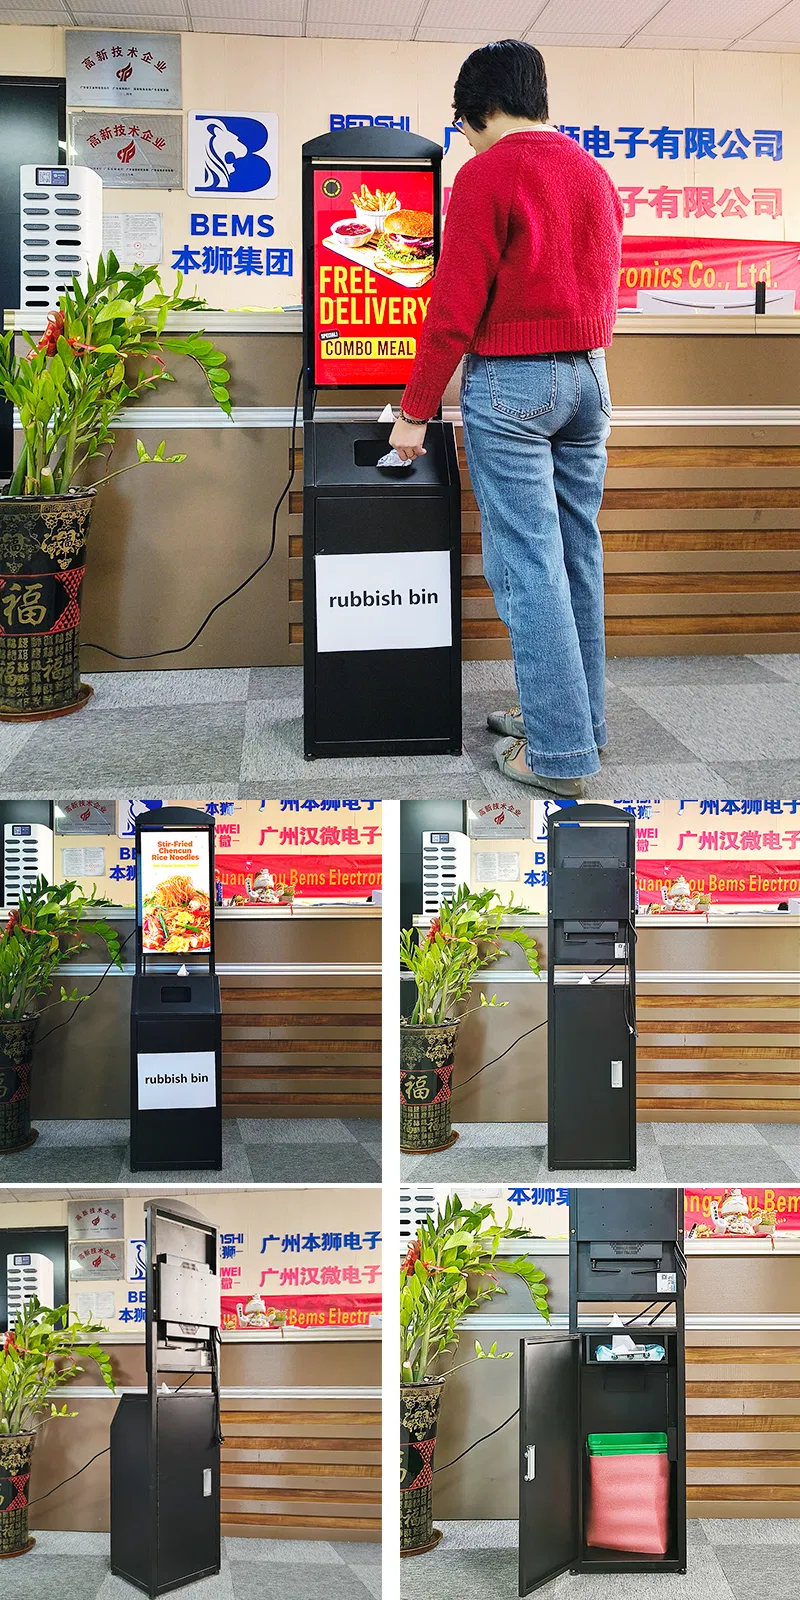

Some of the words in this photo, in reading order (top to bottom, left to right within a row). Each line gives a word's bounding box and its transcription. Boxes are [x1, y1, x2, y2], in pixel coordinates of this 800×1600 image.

[81, 46, 168, 74] 高新技术企业
[86, 123, 166, 151] 高新技术企业
[190, 213, 275, 238] BEMS
[171, 245, 294, 277] 本狮集团
[319, 266, 378, 294] FREE
[319, 296, 432, 325] DELIVERY
[325, 340, 373, 356] COMBO
[377, 340, 414, 356] MEAL
[2, 582, 47, 626] 福
[329, 590, 402, 608] rubbish
[409, 589, 438, 605] bin
[157, 840, 193, 848] Stir-Fried
[259, 826, 382, 847] 广州汉微电子
[677, 830, 800, 851] 广州汉微电子
[289, 869, 325, 886] Bems
[708, 874, 746, 892] Bems
[145, 1072, 188, 1085] rubbish
[191, 1072, 208, 1083] bin
[404, 1074, 430, 1100] 福
[260, 1231, 382, 1254] 广州本狮电子
[259, 1265, 382, 1287] 广州汉微电子
[289, 1309, 325, 1325] Bems
